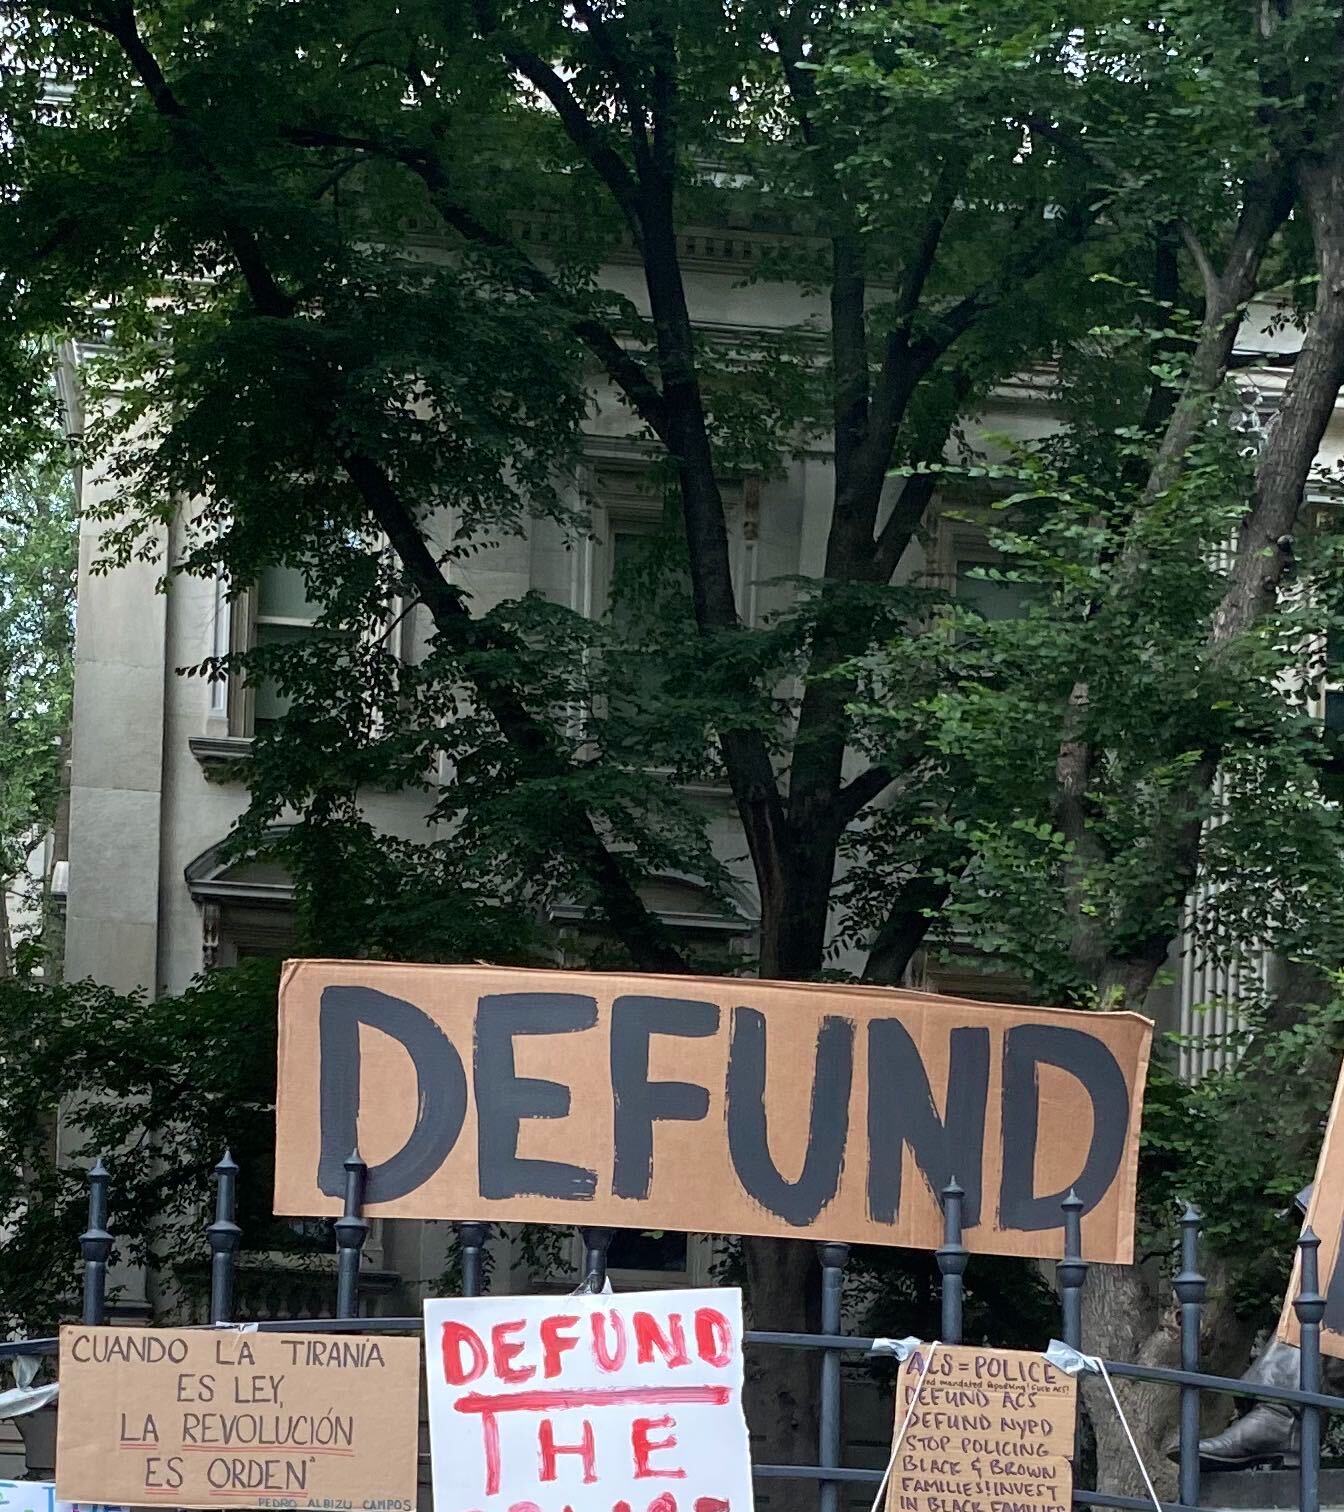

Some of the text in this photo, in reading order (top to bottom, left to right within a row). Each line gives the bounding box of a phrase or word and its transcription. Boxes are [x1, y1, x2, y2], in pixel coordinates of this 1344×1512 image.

[317, 985, 1130, 1232] DEFUND
[216, 1340, 255, 1365] LA
[281, 1338, 385, 1367] TIRANÍA
[442, 1309, 733, 1385] DEFUND
[906, 1352, 954, 1376] ACS
[975, 1356, 1057, 1384] POLICE
[177, 1374, 284, 1409] ES LEY,
[905, 1386, 1037, 1410] DEFUND ACS
[121, 1408, 354, 1446] LA REVOLUCIÓN
[905, 1411, 991, 1431] DEFUND
[476, 1407, 686, 1495] THE
[906, 1435, 1049, 1457] STOP POLICING
[145, 1458, 183, 1488] ES
[903, 1455, 961, 1475] BLACK
[990, 1459, 1056, 1479] BROWN
[258, 1497, 411, 1511] PEDRO ALBIZU CAMPOS
[900, 1496, 918, 1512] IN
